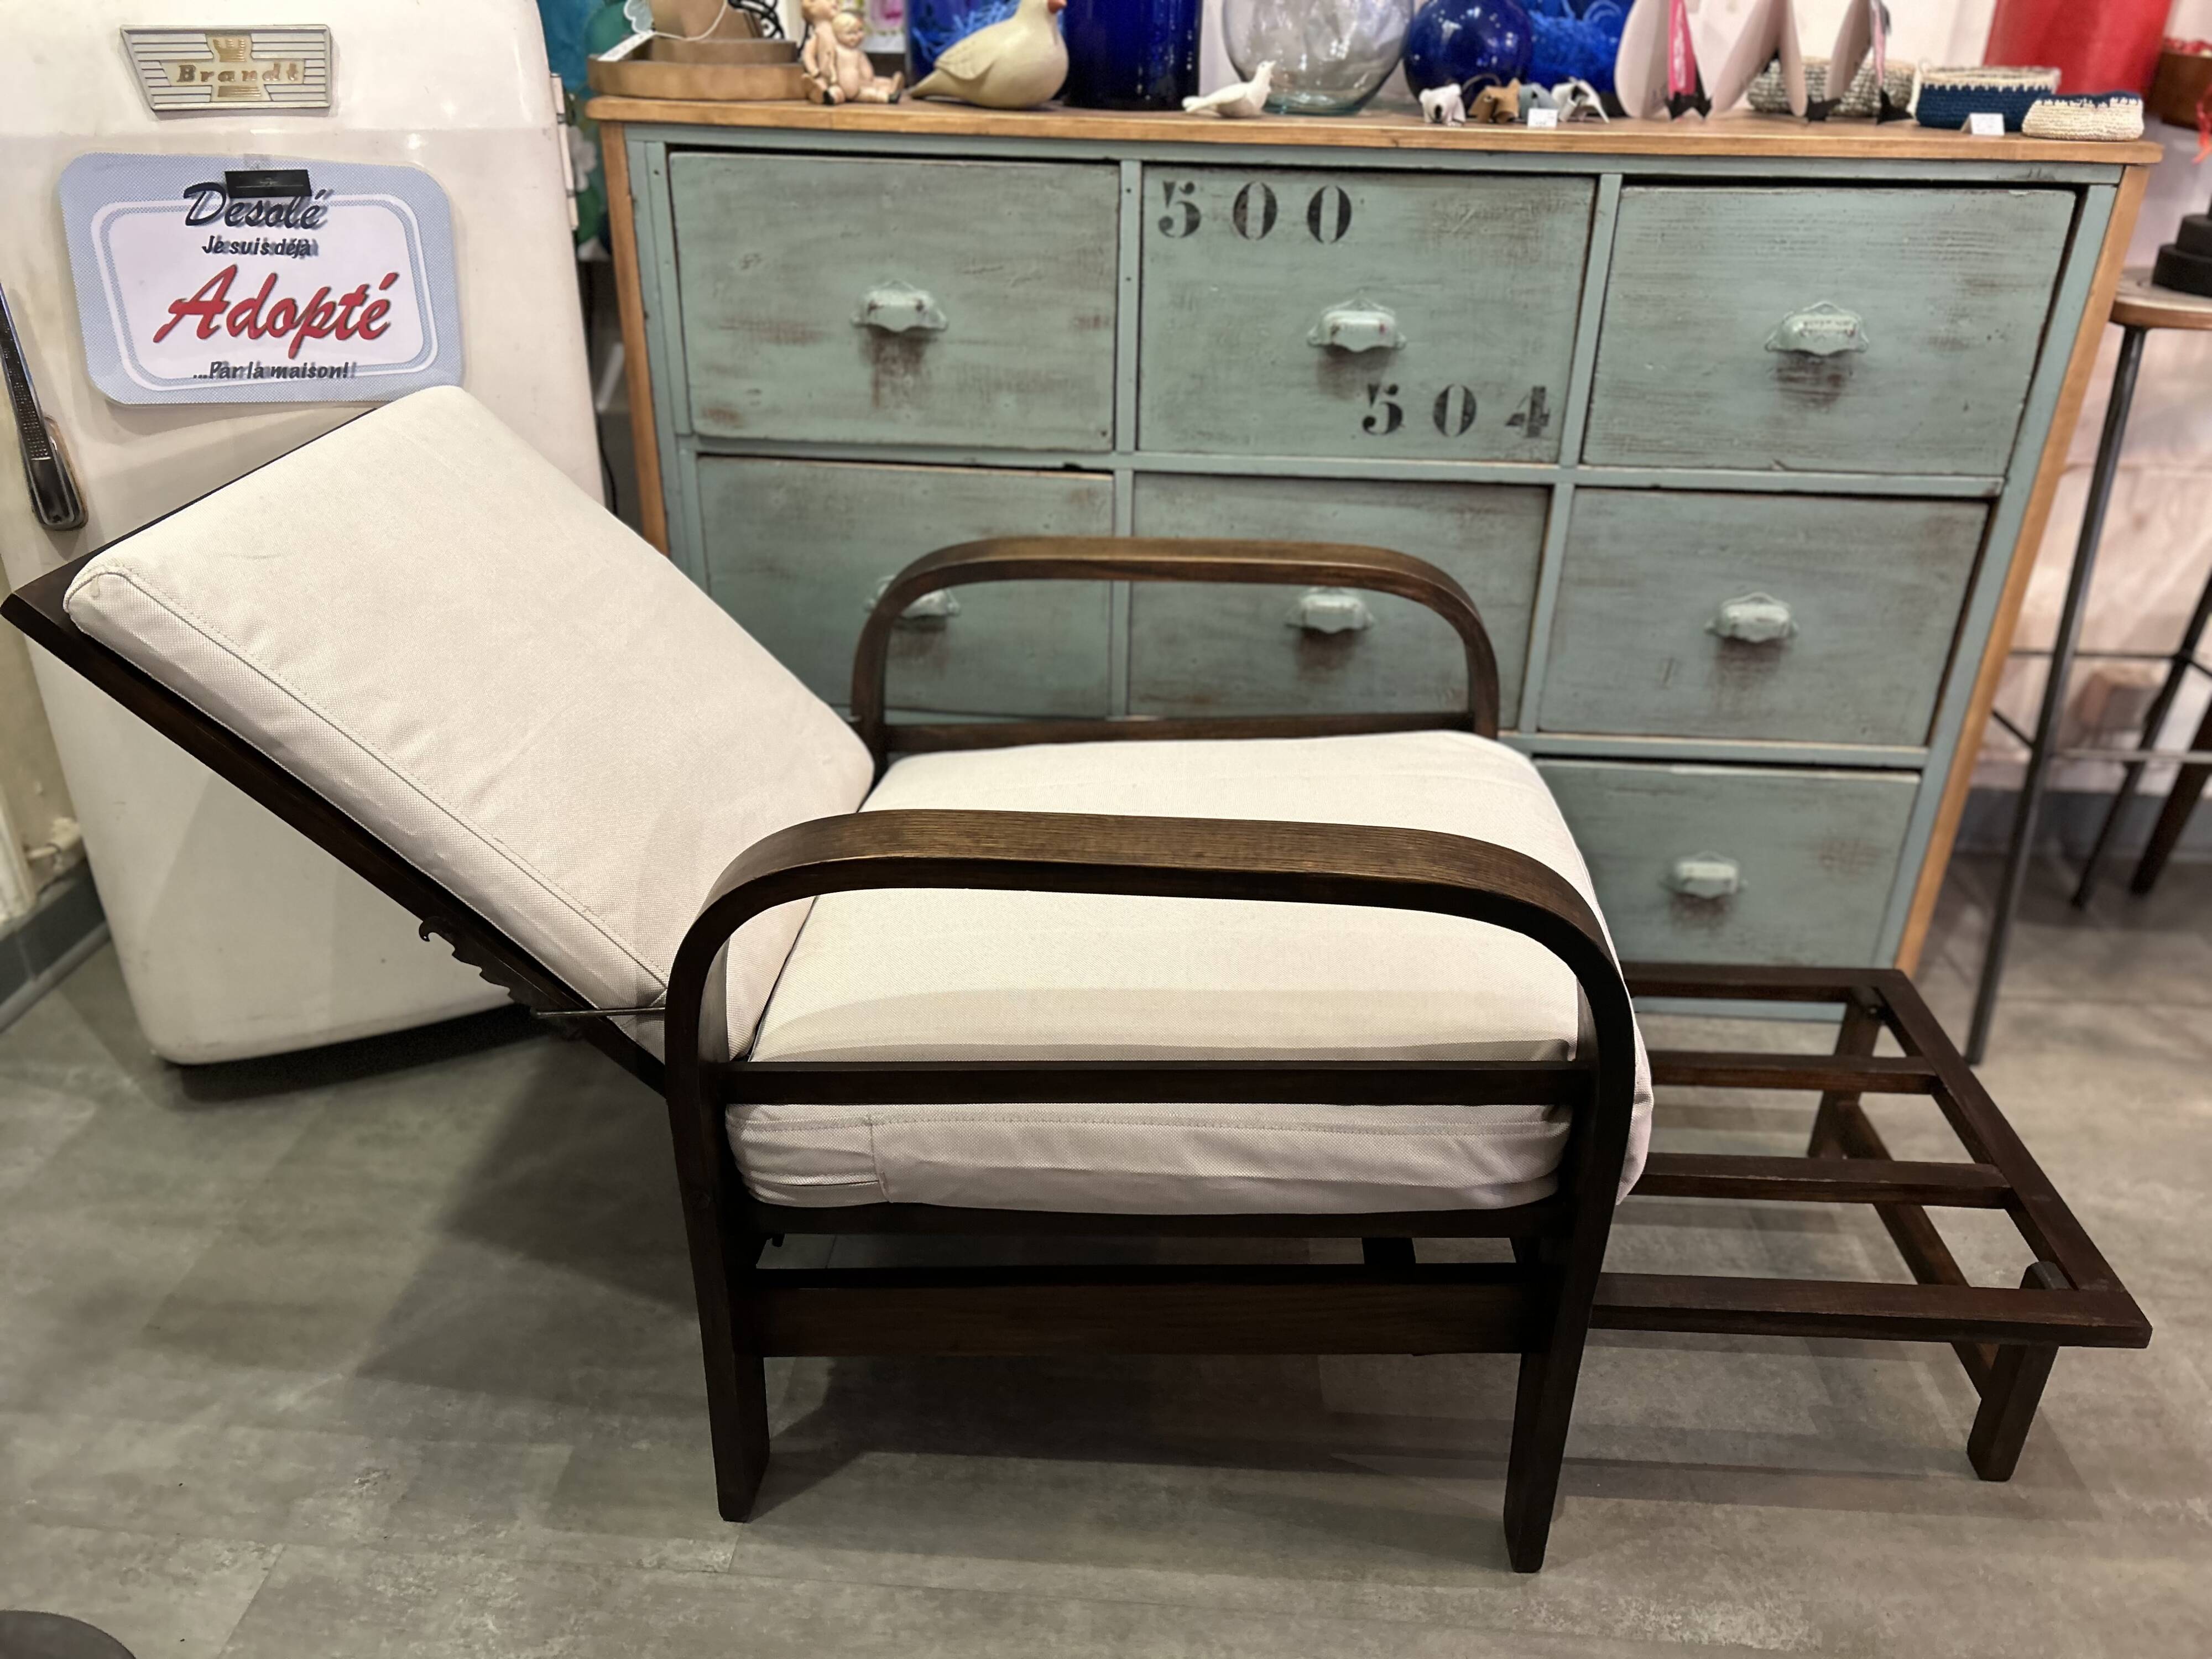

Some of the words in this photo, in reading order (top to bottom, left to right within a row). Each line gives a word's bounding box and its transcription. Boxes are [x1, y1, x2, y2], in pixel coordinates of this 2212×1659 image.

[177, 62, 299, 83] Brandt
[201, 234, 225, 254] Je
[229, 237, 270, 255] suis
[153, 264, 399, 359] Adopté
[271, 361, 349, 379] maison!
